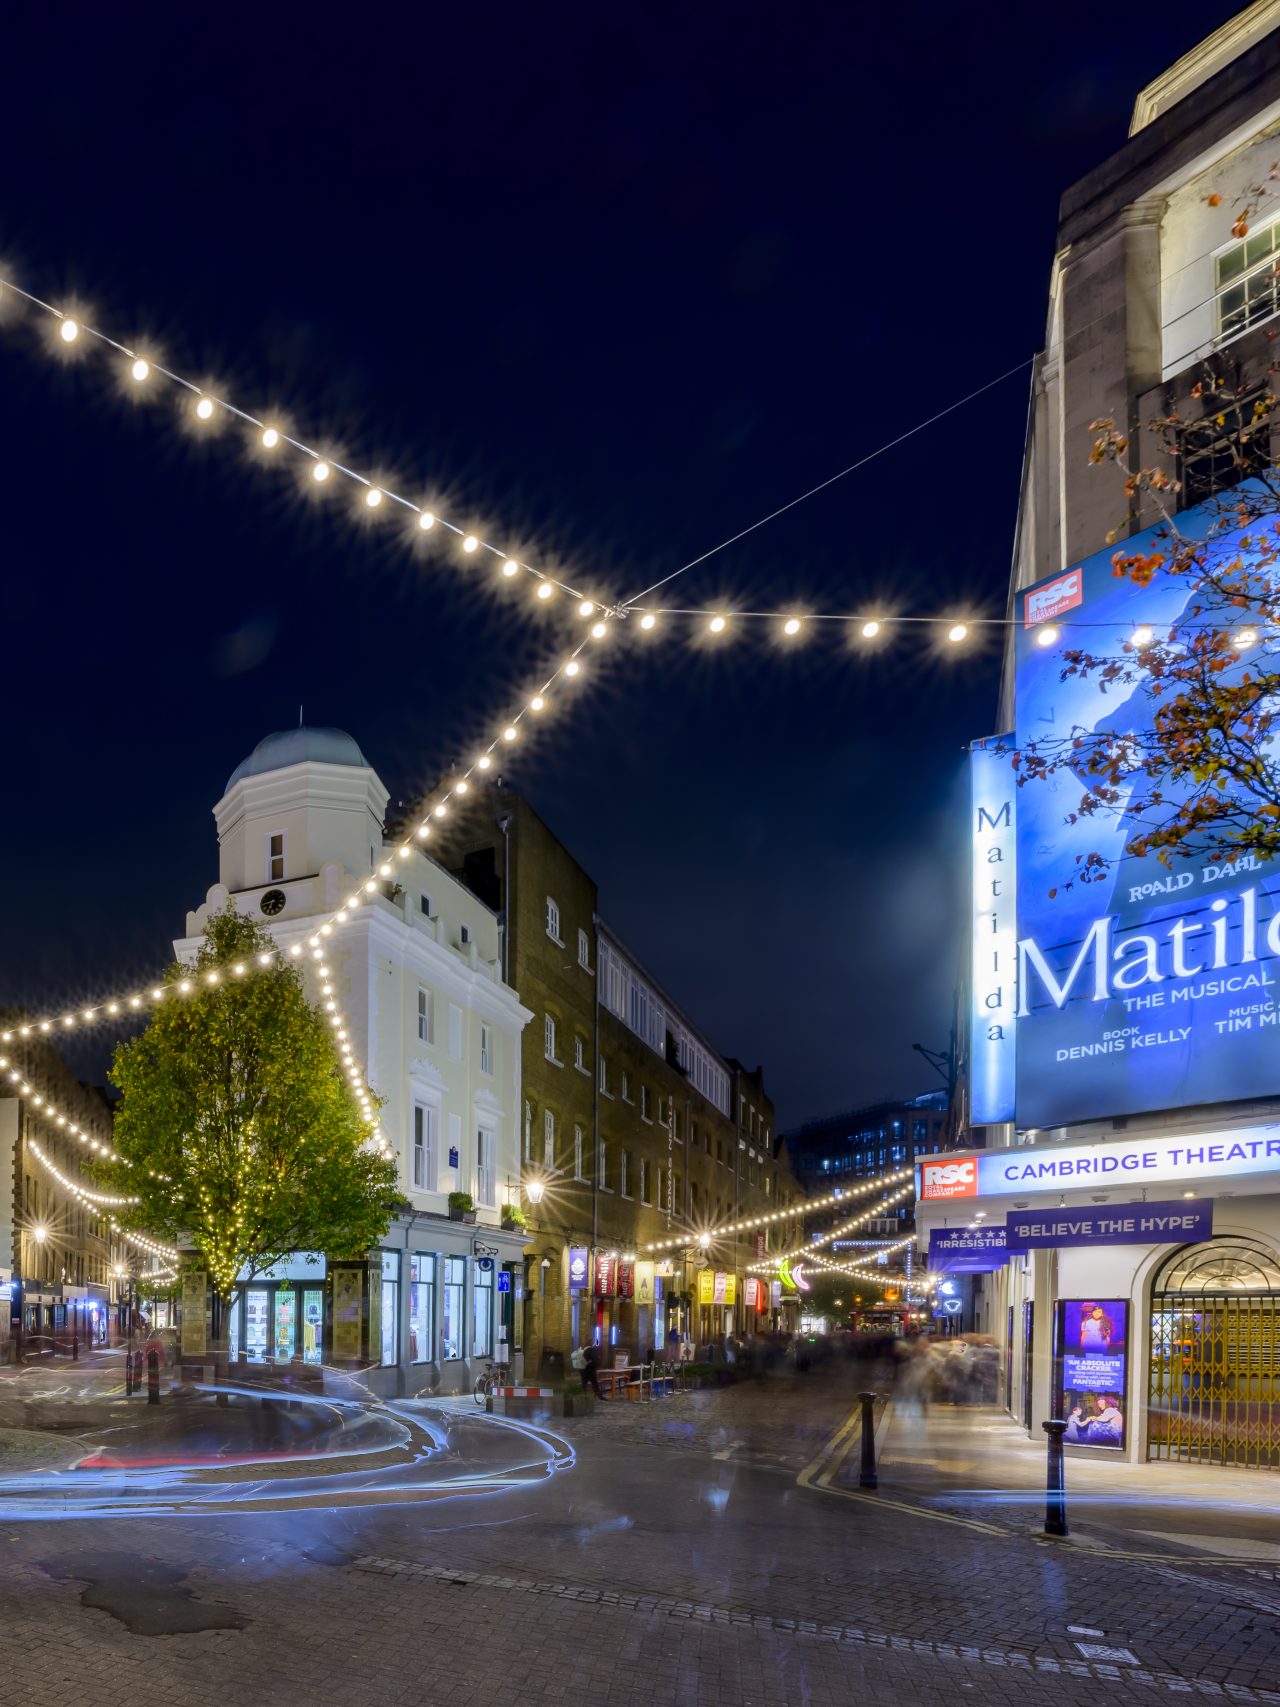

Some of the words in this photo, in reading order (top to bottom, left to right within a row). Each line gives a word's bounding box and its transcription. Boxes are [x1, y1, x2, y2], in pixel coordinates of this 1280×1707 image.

[1028, 575, 1078, 612] RSC
[1128, 872, 1194, 902] ROALD
[1202, 855, 1262, 883] DAHL
[976, 801, 1013, 1041] Matilda
[1124, 992, 1165, 1012] THE
[1171, 971, 1276, 1003] MUSICAL
[1229, 1001, 1274, 1017] MUSIC
[1103, 1026, 1140, 1041] BOOK
[1214, 1016, 1251, 1034] TIM
[1056, 1039, 1125, 1062] DENNIS
[1131, 1027, 1192, 1049] KELLY
[925, 1162, 974, 1185] RSC
[1004, 1152, 1157, 1180] CAMBRIDGE
[1097, 1219, 1135, 1234] THE
